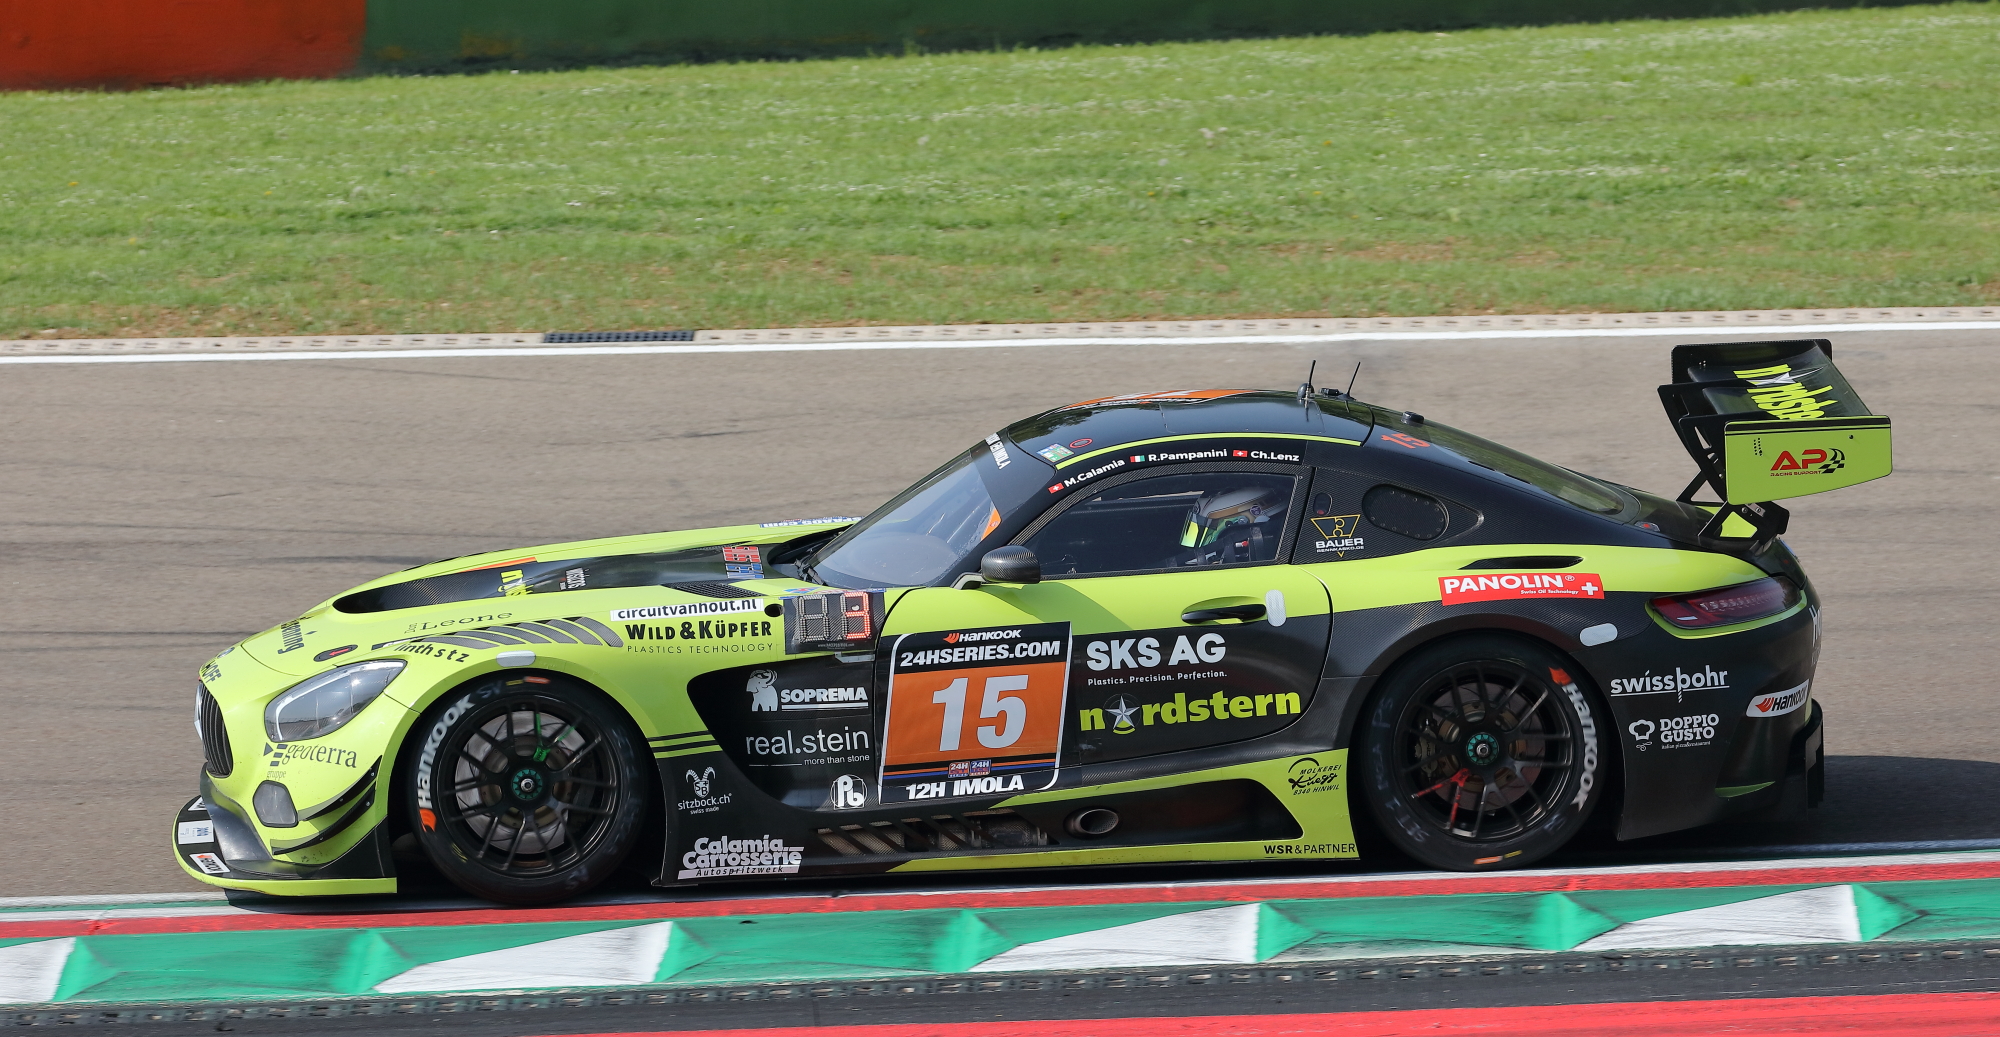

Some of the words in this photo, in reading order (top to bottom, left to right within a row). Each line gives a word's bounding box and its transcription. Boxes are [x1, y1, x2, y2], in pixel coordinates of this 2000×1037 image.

[1381, 433, 1430, 449] 15
[1148, 449, 1227, 462] R.Pampanini
[1250, 450, 1299, 462] Ch.Lenz
[1770, 449, 1827, 471] AP
[1064, 459, 1125, 487] M.Calamia
[1316, 538, 1364, 548] BAUER
[617, 599, 757, 620] circuitvanhout.nl
[420, 613, 512, 631] Leone
[627, 645, 682, 654] PLASTICS
[689, 643, 773, 653] TECHNOLOGY
[900, 640, 1061, 667] 24HSERIES.COM
[1086, 637, 1161, 671] SKS
[1167, 632, 1226, 666] AG
[1088, 677, 1127, 686] Plastics.
[1129, 674, 1175, 684] Precision.
[1177, 670, 1228, 681] Perfection.
[781, 687, 868, 702] SOPREMA
[932, 675, 1029, 752] 15
[1660, 714, 1719, 731] DOPPIO
[745, 726, 869, 755] real.stein
[1661, 726, 1715, 743] GUSTO
[282, 743, 357, 768] geoterra
[827, 756, 845, 764] than
[847, 754, 870, 762] stone
[951, 762, 968, 770] 24H
[972, 761, 989, 769] 24H
[1300, 764, 1342, 775] MOLKEREI
[906, 782, 946, 800] 12H
[953, 775, 1024, 796] IMOLA
[1313, 784, 1340, 792] HINWIL
[678, 794, 731, 810] sitzbock.ch
[694, 834, 783, 856] Calamia
[683, 850, 802, 869] Carrosserie
